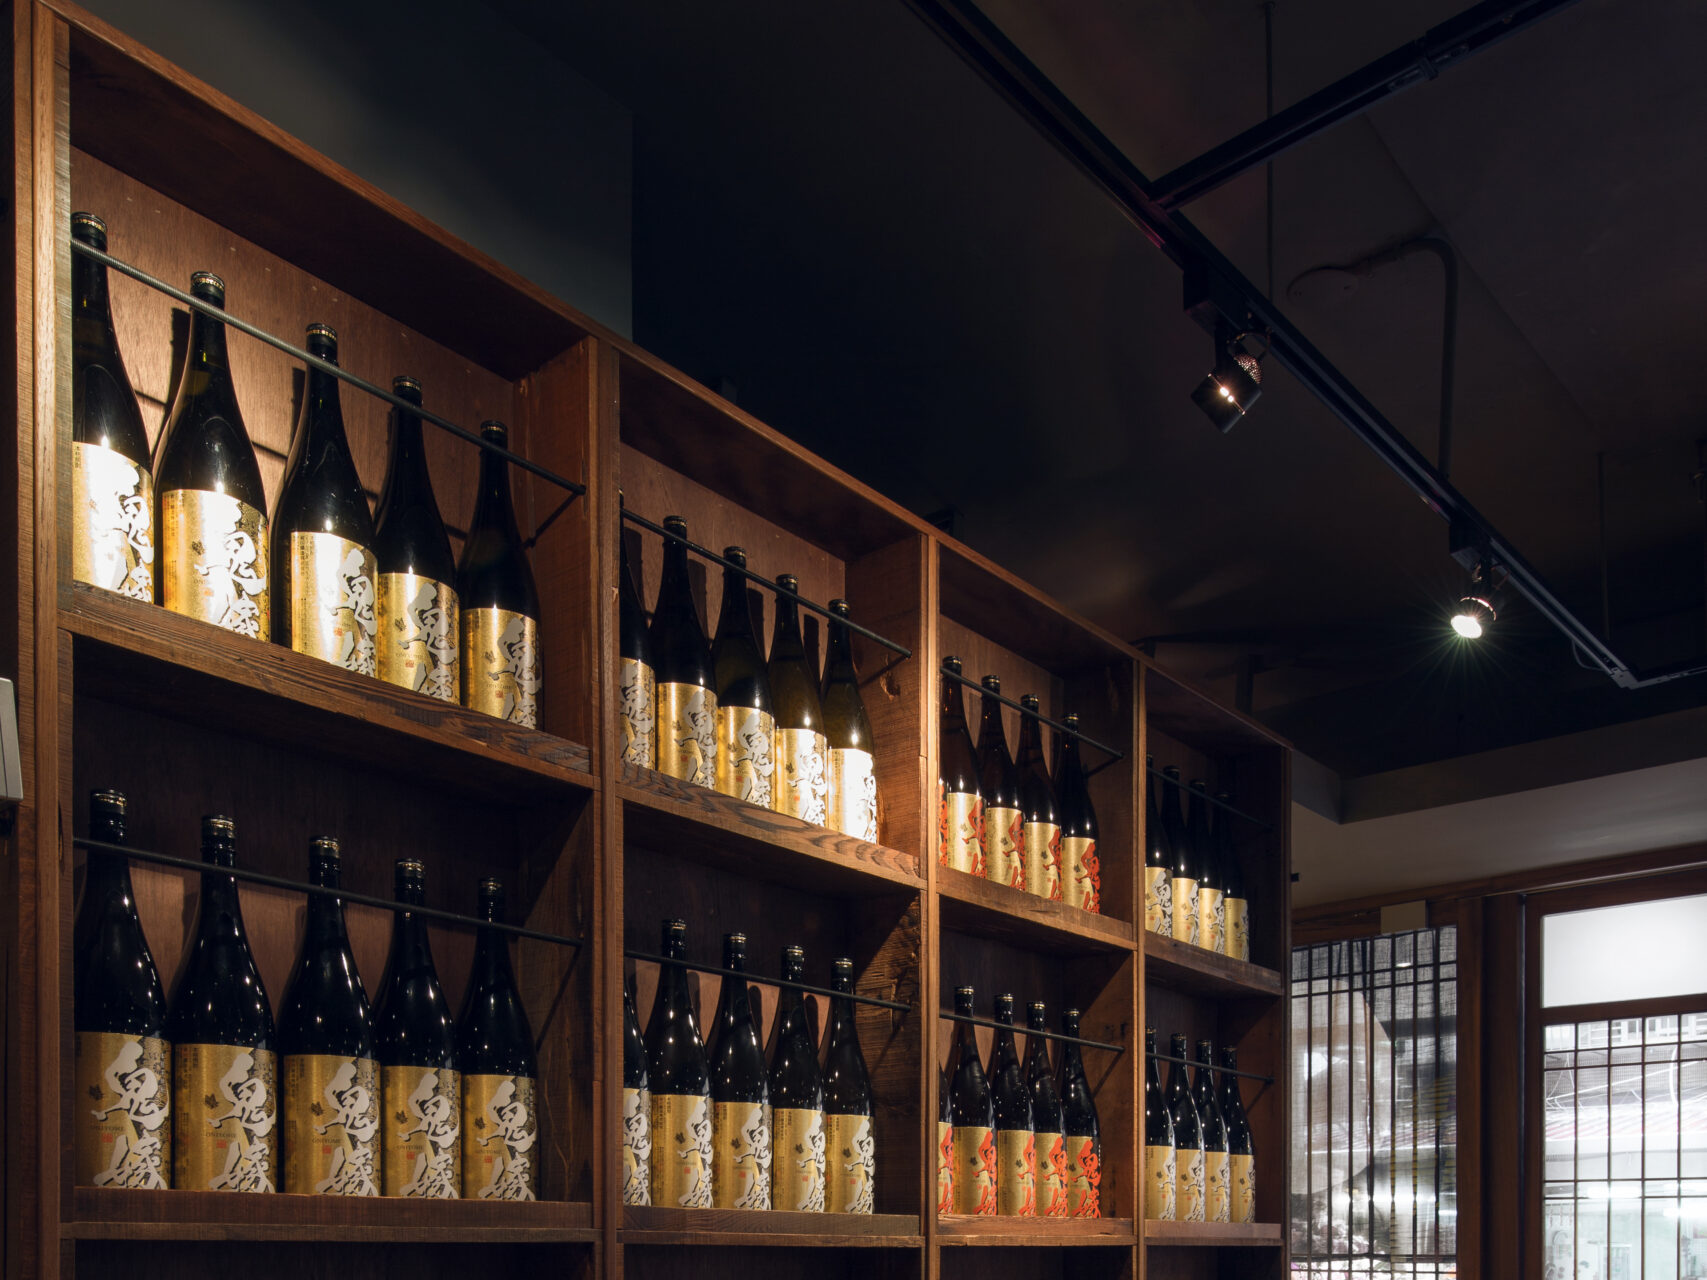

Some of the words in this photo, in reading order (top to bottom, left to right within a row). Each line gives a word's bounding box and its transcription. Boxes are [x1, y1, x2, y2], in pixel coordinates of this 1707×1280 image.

[397, 582, 457, 701] 鬼嫁
[488, 617, 542, 729] 鬼嫁
[91, 1041, 169, 1188] 鬼嫁
[207, 1053, 277, 1192] 鬼嫁
[314, 1062, 379, 1196] 鬼嫁
[397, 1072, 459, 1199] 鬼嫁
[477, 1080, 537, 1201] 鬼嫁
[734, 1107, 773, 1210] 鬼嫁
